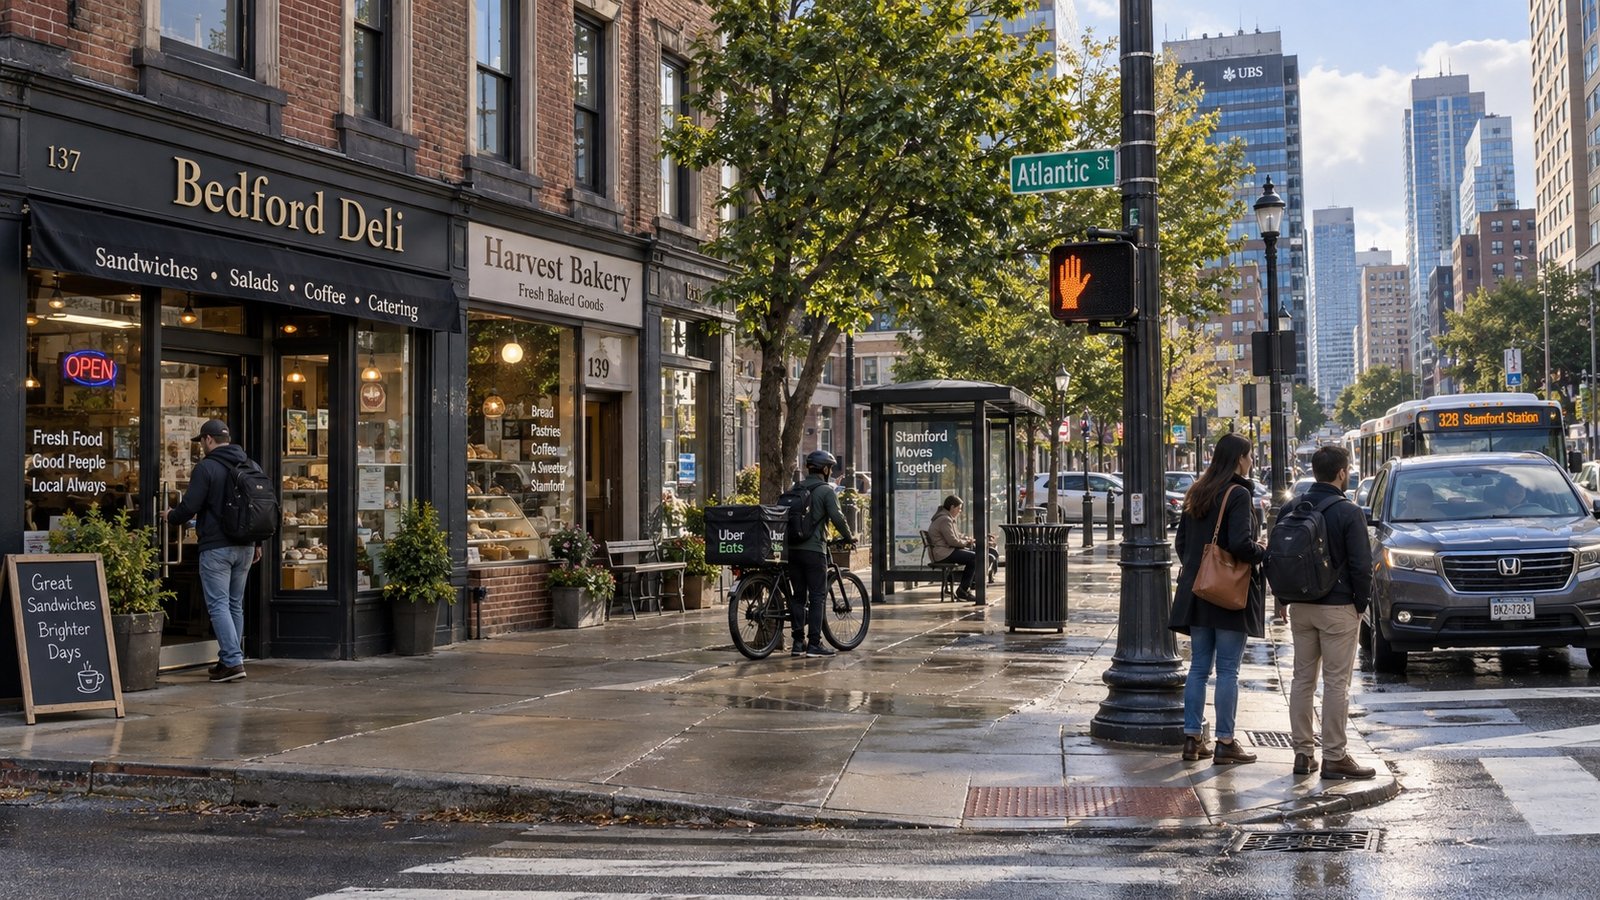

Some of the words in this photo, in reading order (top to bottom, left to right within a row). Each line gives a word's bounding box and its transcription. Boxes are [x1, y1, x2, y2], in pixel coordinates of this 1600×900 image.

[1238, 66, 1263, 78] UBS
[48, 145, 80, 172] 137
[1017, 158, 1090, 186] Atlantic
[1097, 156, 1110, 170] St
[173, 156, 325, 234] Bedford
[339, 198, 404, 252] Deli
[484, 235, 563, 281] Harvest
[570, 256, 631, 302] Bakery
[96, 247, 198, 281] Sandwiches
[230, 269, 279, 292] Salads
[304, 282, 346, 305] Coffee
[368, 294, 418, 322] Catering
[519, 283, 544, 300] Fresh
[548, 288, 574, 306] Baked
[578, 295, 604, 312] Goods
[66, 356, 114, 380] OPEN
[588, 357, 609, 379] 139
[532, 405, 554, 418] Bread
[1438, 412, 1458, 427] 328
[1464, 412, 1504, 425] Stamford
[1507, 411, 1538, 423] Station
[33, 429, 68, 446] Fresh
[73, 431, 103, 446] Food
[531, 424, 561, 437] Pastries
[896, 429, 947, 442] Stamford
[531, 442, 556, 456] Coffee
[896, 446, 932, 458] Moves
[32, 453, 65, 469] Good
[68, 454, 106, 472] Peeple
[530, 461, 536, 474] A
[896, 461, 947, 476] Together
[32, 477, 63, 492] Local
[66, 477, 106, 496] Always
[531, 479, 565, 492] Stamford
[719, 529, 744, 540] Uber
[719, 542, 743, 553] Eats
[32, 573, 73, 591] Great
[28, 596, 96, 613] Sandwiches
[38, 621, 90, 642] Brighter
[48, 643, 81, 663] Days
